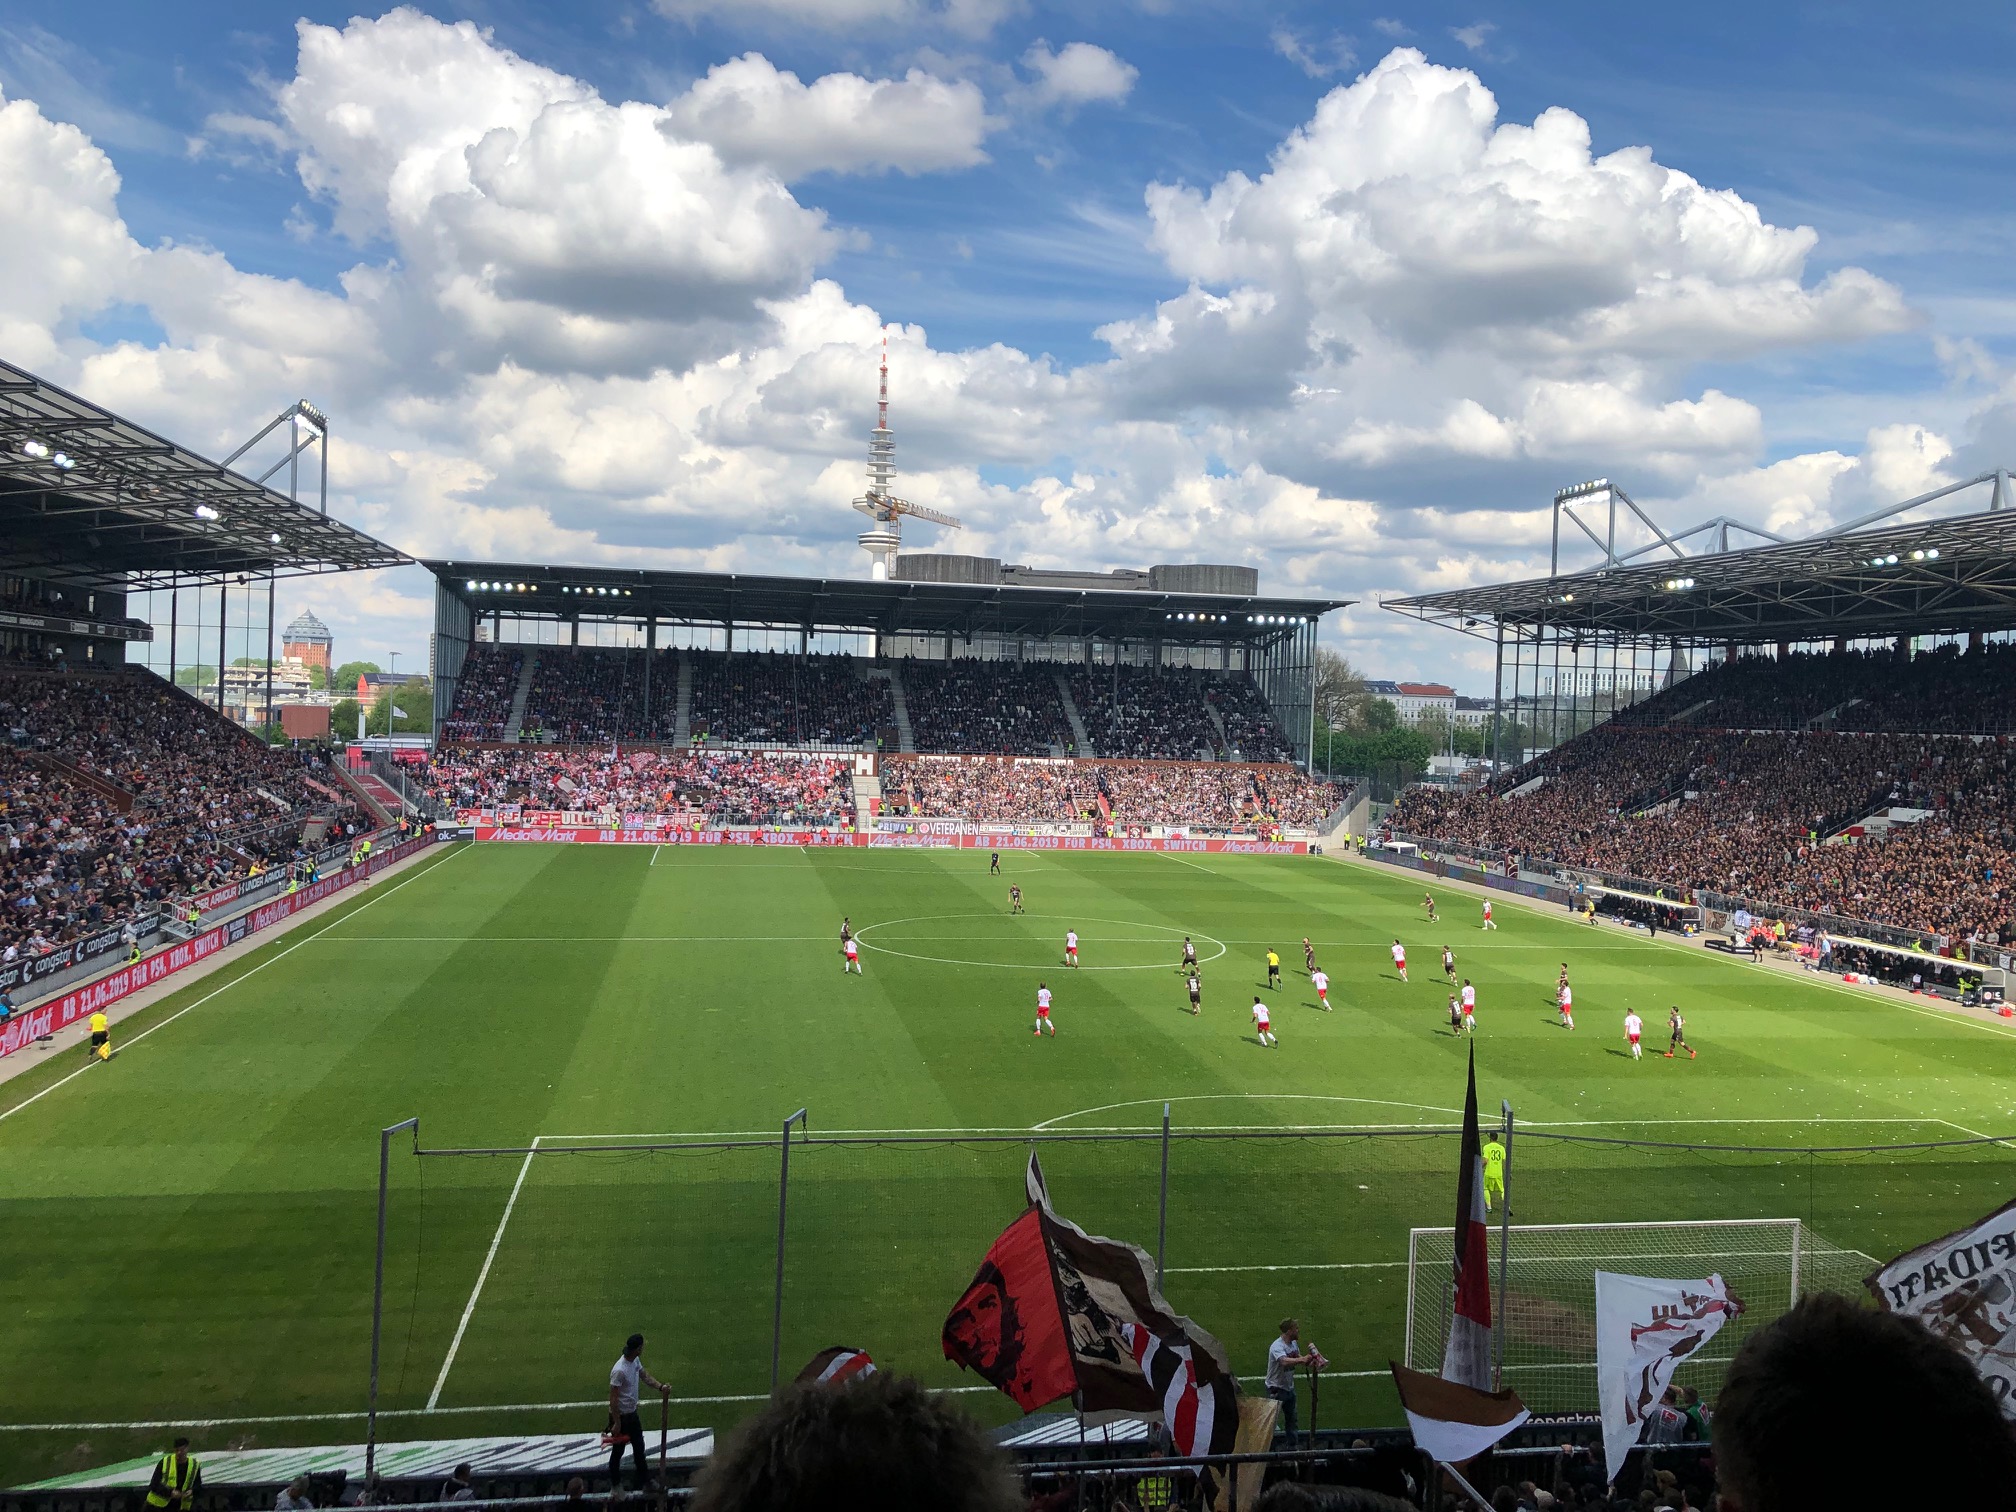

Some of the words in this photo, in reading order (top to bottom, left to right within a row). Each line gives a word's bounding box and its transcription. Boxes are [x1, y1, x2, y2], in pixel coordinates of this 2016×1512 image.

[599, 831, 616, 842] AB
[622, 831, 692, 842] 21.06.019
[930, 823, 979, 836] VETERANEN
[974, 836, 990, 847] AB
[995, 837, 1059, 848] 21.06.2019
[1064, 837, 1086, 848] FÜR
[1163, 840, 1207, 851] SWITCH
[245, 875, 264, 892] UNDER
[264, 867, 286, 885] ARMOUR
[87, 931, 119, 954] congstar
[36, 949, 72, 974] congstar
[62, 996, 76, 1024] AB
[80, 971, 129, 1014] 21.06.2019
[131, 963, 148, 988] FÜR
[194, 930, 219, 958] SWITCH
[1490, 1149, 1501, 1162] 33
